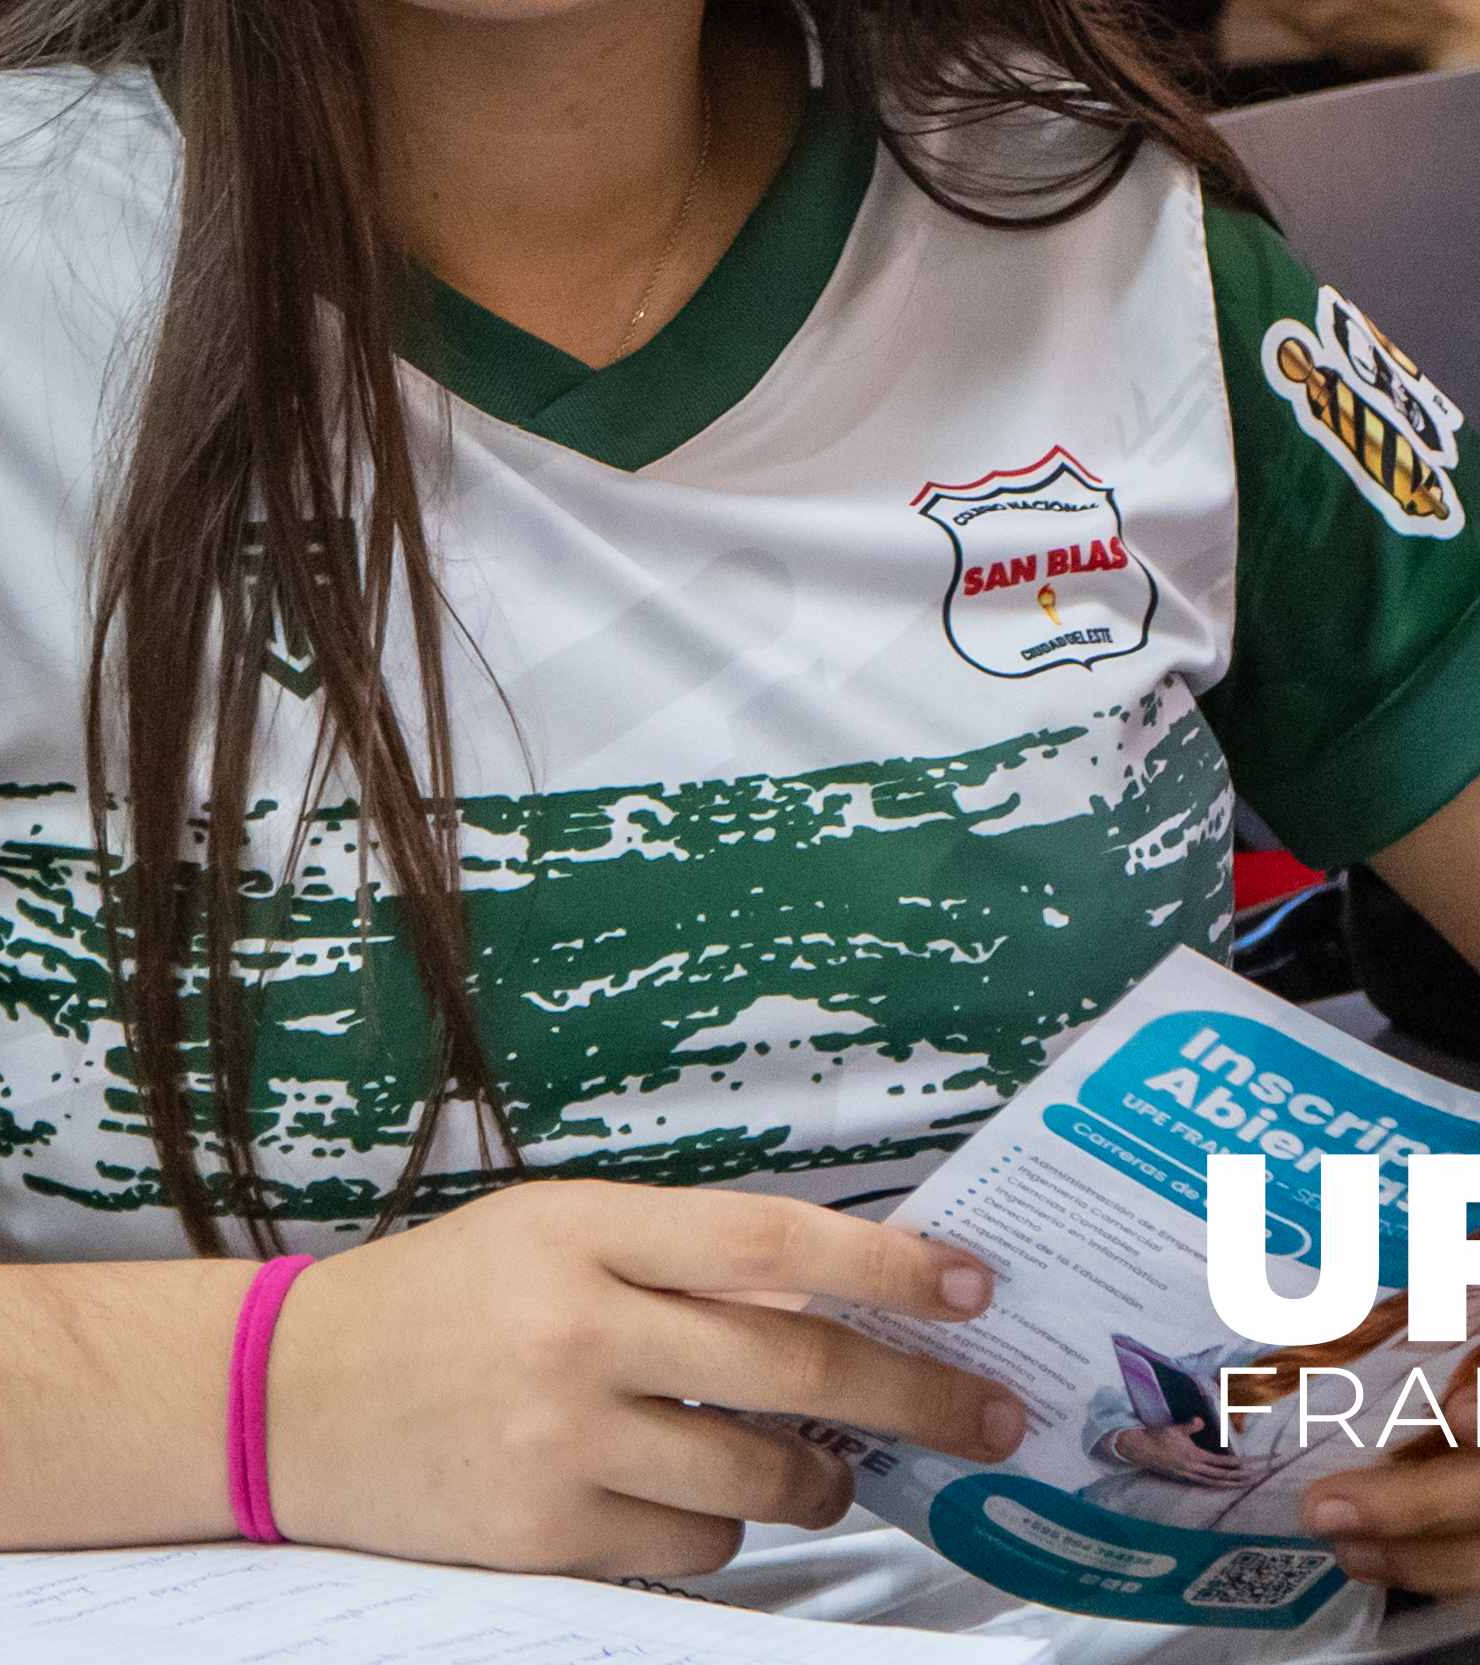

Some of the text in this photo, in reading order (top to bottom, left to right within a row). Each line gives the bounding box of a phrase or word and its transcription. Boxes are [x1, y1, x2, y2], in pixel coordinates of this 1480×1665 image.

[963, 536, 1129, 596] SAN BLAS
[1122, 1092, 1172, 1127] UPE
[1072, 1122, 1200, 1200] Carreras de
[983, 1196, 1042, 1232] Derecho
[1006, 1175, 1140, 1256] Ciencias Contables
[1029, 1155, 1135, 1219] Administración
[1138, 1217, 1156, 1231] de
[947, 1228, 1011, 1268] Medicina
[960, 1218, 1048, 1270] Arquitectura
[972, 1206, 1033, 1244] Ciencias
[1035, 1242, 1054, 1256] de
[1067, 1227, 1086, 1241] en
[1090, 1207, 1164, 1253] Comercial
[1011, 1312, 1090, 1366] Fisioterapia
